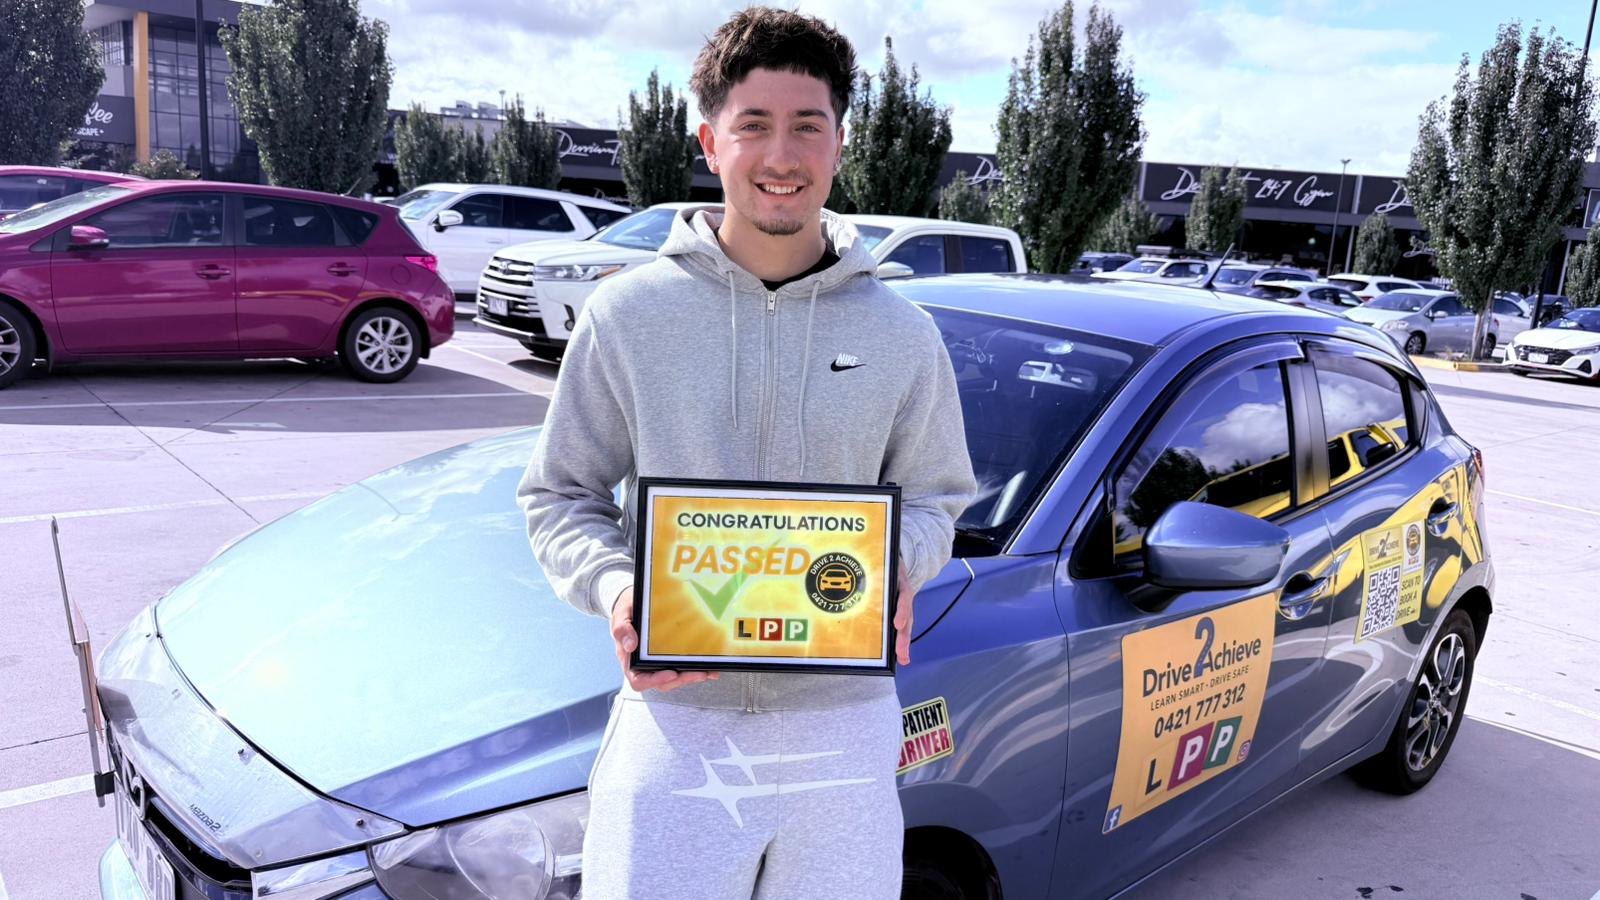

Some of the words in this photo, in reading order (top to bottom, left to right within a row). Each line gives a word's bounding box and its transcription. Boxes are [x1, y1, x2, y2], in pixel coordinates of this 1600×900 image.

[1294, 175, 1334, 207] Gym
[836, 353, 858, 366] NIKE
[677, 512, 866, 532] CONGRATULATIONS
[672, 544, 811, 576] PASSED
[810, 557, 829, 575] DRIVE
[835, 555, 863, 577] ACHIEVE
[811, 592, 827, 608] 0421
[828, 603, 845, 611] 777
[1396, 606, 1411, 621] DRIVE
[1399, 592, 1413, 605] BOOK
[738, 620, 752, 638] L
[764, 621, 779, 638] P
[789, 621, 804, 639] P
[1193, 616, 1215, 679] 2
[1202, 638, 1261, 673] Achieve
[1142, 661, 1192, 698] Drive
[1150, 693, 1177, 711] LEARN
[1178, 682, 1204, 700] SMART
[1210, 673, 1231, 688] DRIVE
[1232, 665, 1249, 679] SAFE
[902, 702, 944, 738] PATIENT
[1154, 705, 1192, 739] 0421
[1195, 693, 1222, 721] 777
[1222, 683, 1246, 709] 312
[1145, 758, 1162, 796] L
[1177, 735, 1204, 780] P
[1210, 725, 1234, 762] P
